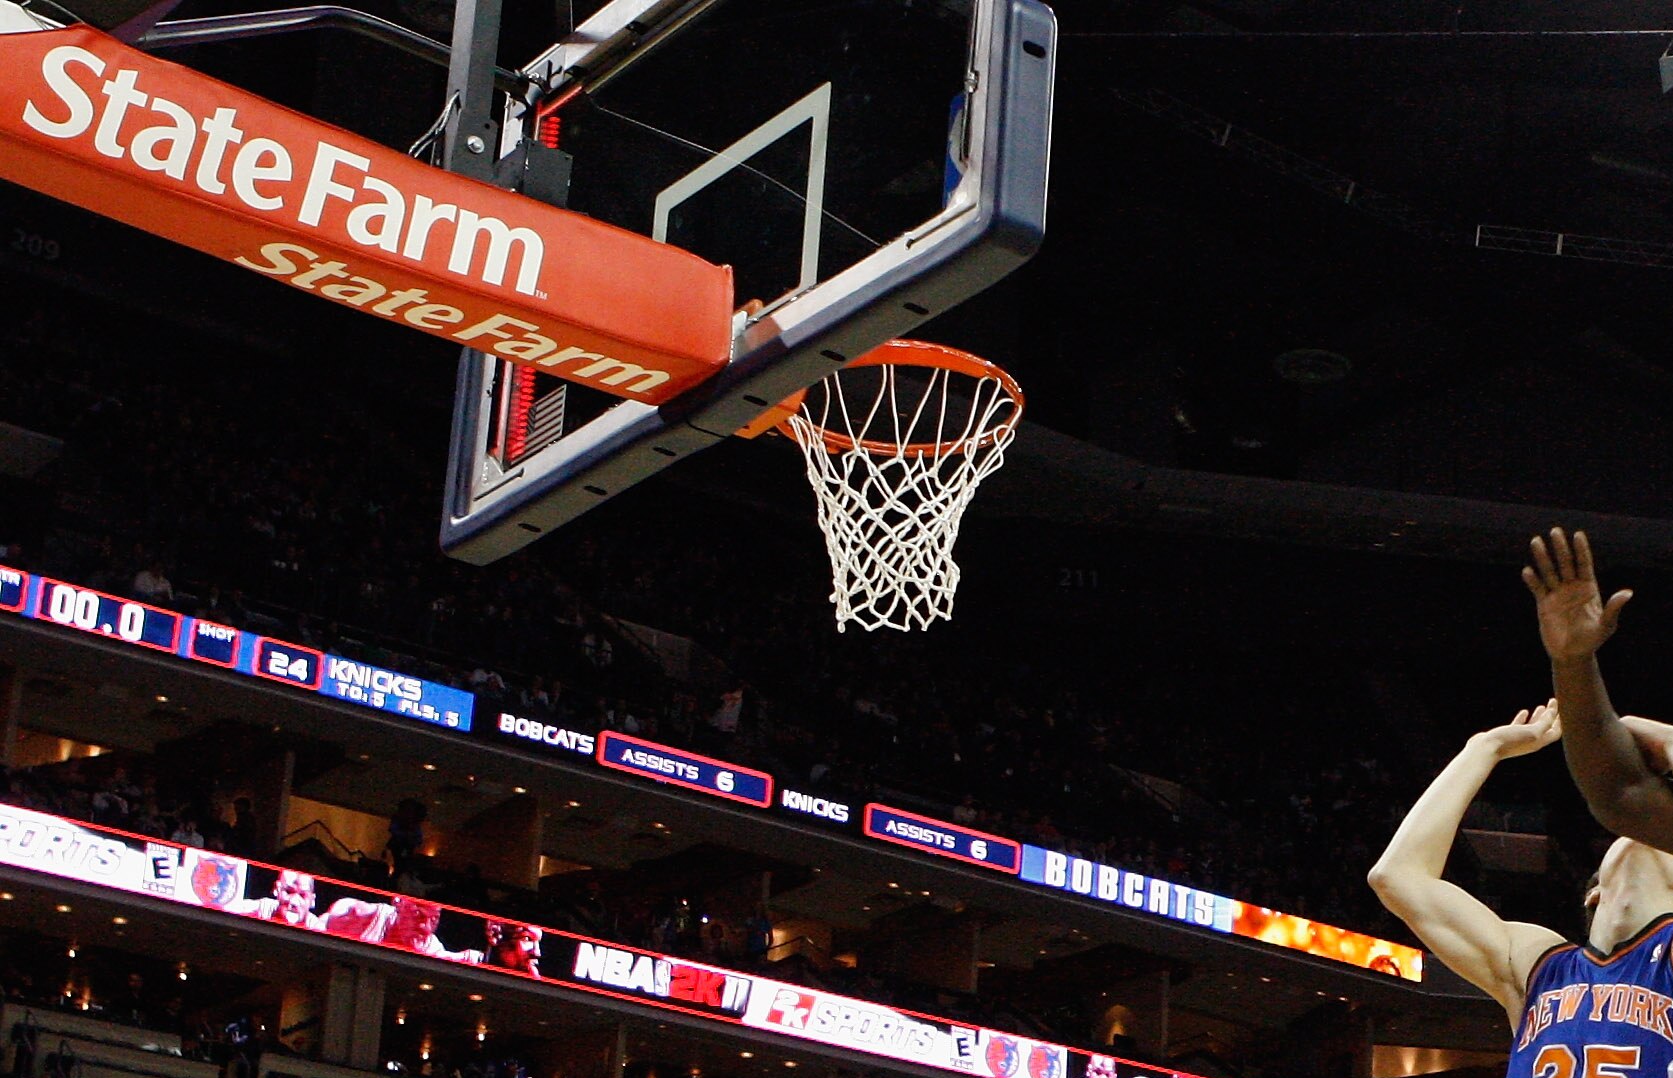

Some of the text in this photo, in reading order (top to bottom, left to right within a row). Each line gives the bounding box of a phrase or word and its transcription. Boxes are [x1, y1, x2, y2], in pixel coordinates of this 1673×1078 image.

[22, 45, 545, 294] State Farm
[235, 242, 670, 394] State Farm
[51, 584, 145, 642] 00.0
[268, 651, 308, 681] 24
[329, 658, 422, 701] KNICKS
[372, 692, 386, 708] 5
[446, 711, 460, 727] 5
[499, 713, 735, 792] BOBCATS ASSISTS 6
[782, 789, 988, 861] KNICKS ASSISTS 6
[1046, 849, 1215, 926] BOBCATS
[574, 943, 656, 995] NBA
[815, 1003, 939, 1055] SPORTS
[1517, 984, 1590, 1053] NEW
